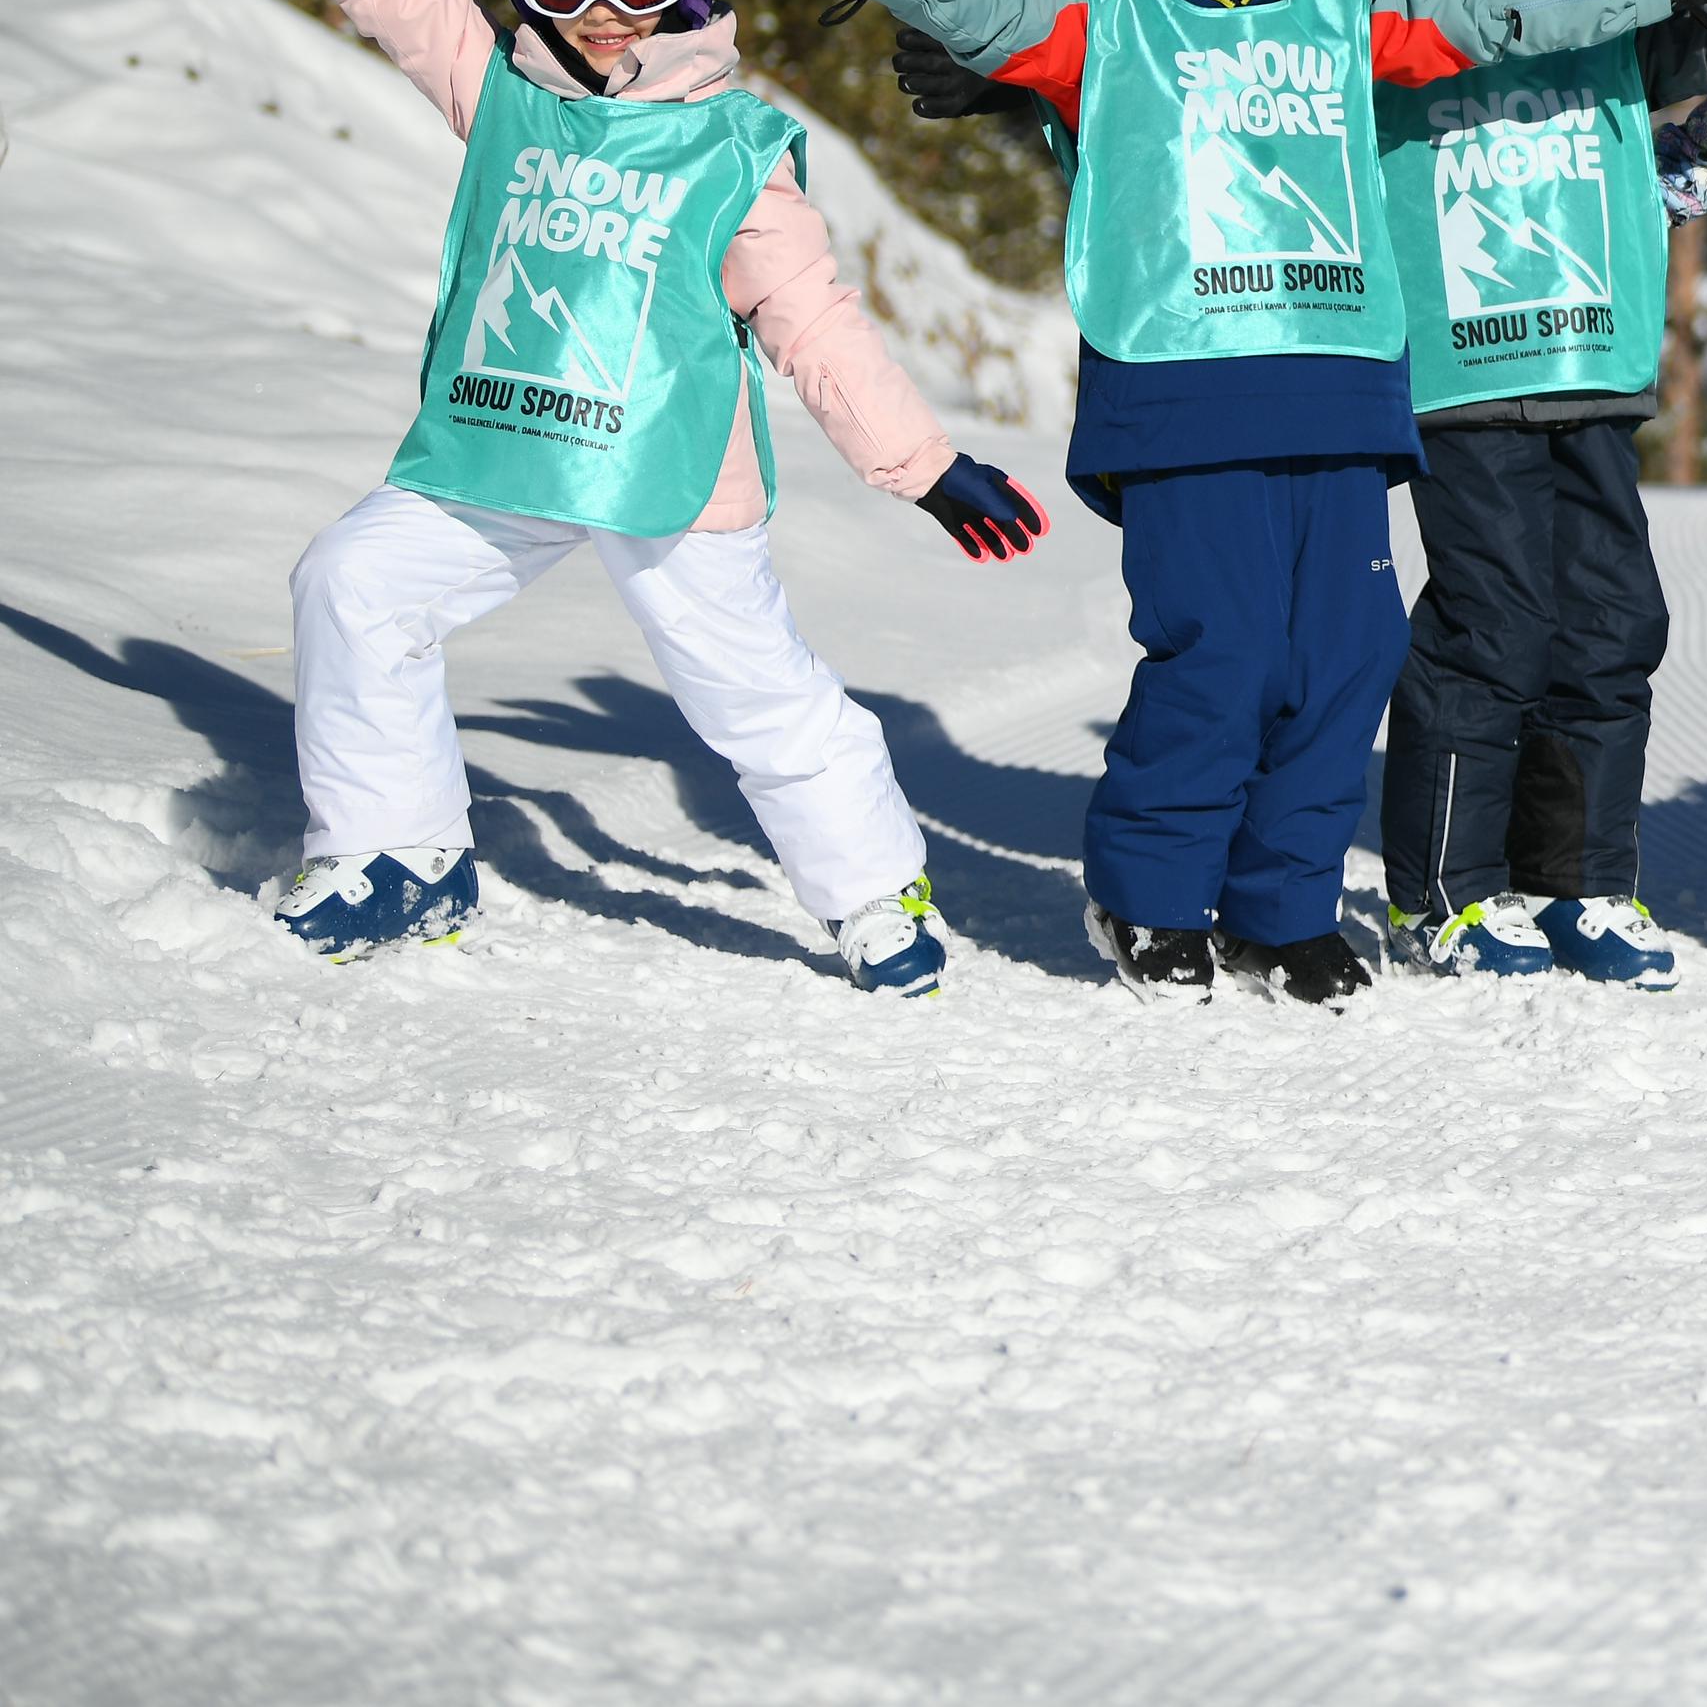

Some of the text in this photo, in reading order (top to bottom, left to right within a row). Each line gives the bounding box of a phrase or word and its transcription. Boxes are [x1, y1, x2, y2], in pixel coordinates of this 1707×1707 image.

[1174, 39, 1333, 90] SNOW
[1184, 85, 1346, 137] MORE
[1427, 88, 1595, 146] SNOW
[506, 146, 688, 221] SNOW
[1434, 133, 1602, 192] MORE
[502, 198, 671, 270] MORE
[1194, 263, 1365, 296] SNOW SPORTS
[1205, 304, 1225, 315] DAHA
[1293, 301, 1311, 310] DAHA
[1312, 302, 1333, 310] MUTLU
[1451, 307, 1614, 350] SNOW SPORTS
[1464, 358, 1483, 367] DAHA
[1547, 345, 1566, 355] DAHA
[1568, 344, 1590, 352] MUTLU
[449, 375, 625, 434] SNOW SPORTS
[453, 415, 466, 425] DAHA
[522, 428, 541, 438] DAHA
[543, 432, 569, 443] MUTLU
[570, 437, 609, 451] ÇOCUKLAR
